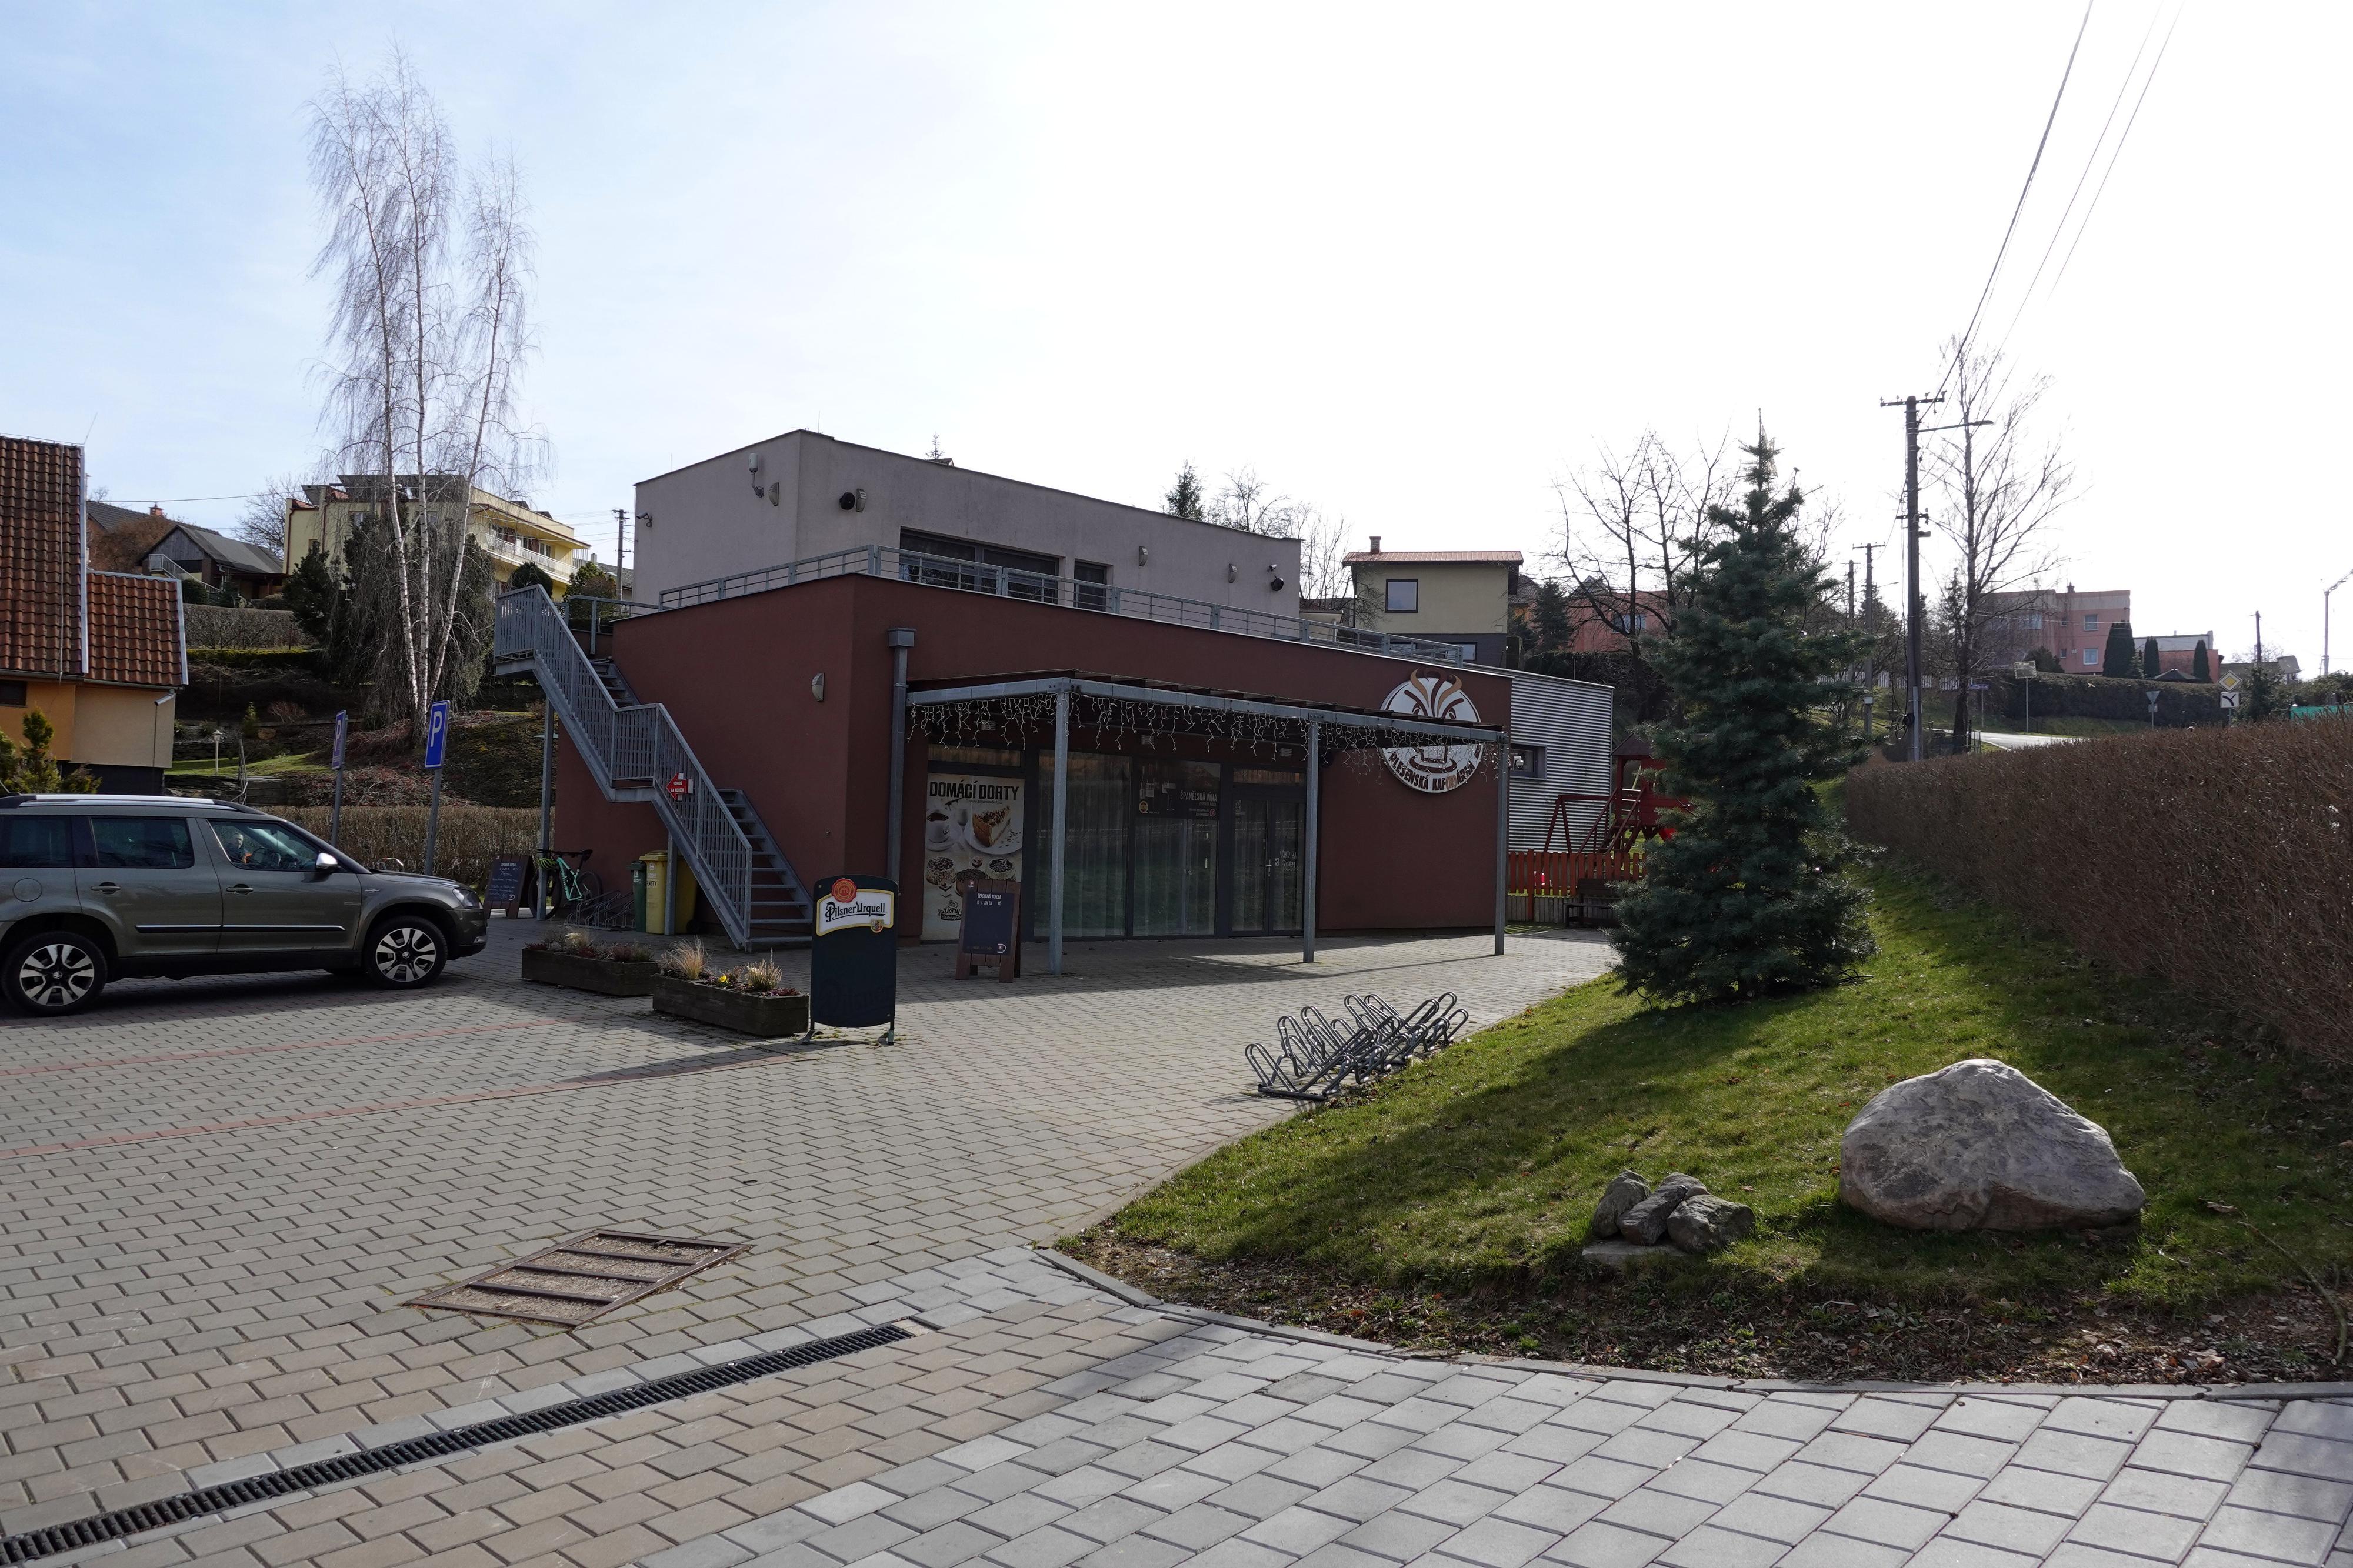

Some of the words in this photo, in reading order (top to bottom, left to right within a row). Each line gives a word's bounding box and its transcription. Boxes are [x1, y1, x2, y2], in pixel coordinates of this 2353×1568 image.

[335, 720, 342, 752] P
[431, 711, 443, 748] P
[929, 779, 978, 799] DOMÁCÍ
[979, 785, 1019, 800] DORTY
[1180, 790, 1205, 801] ŠPANĚLSKÁ
[1207, 792, 1217, 802] VÍNA
[825, 901, 856, 923] Pilsner
[856, 900, 885, 917] Urquell
